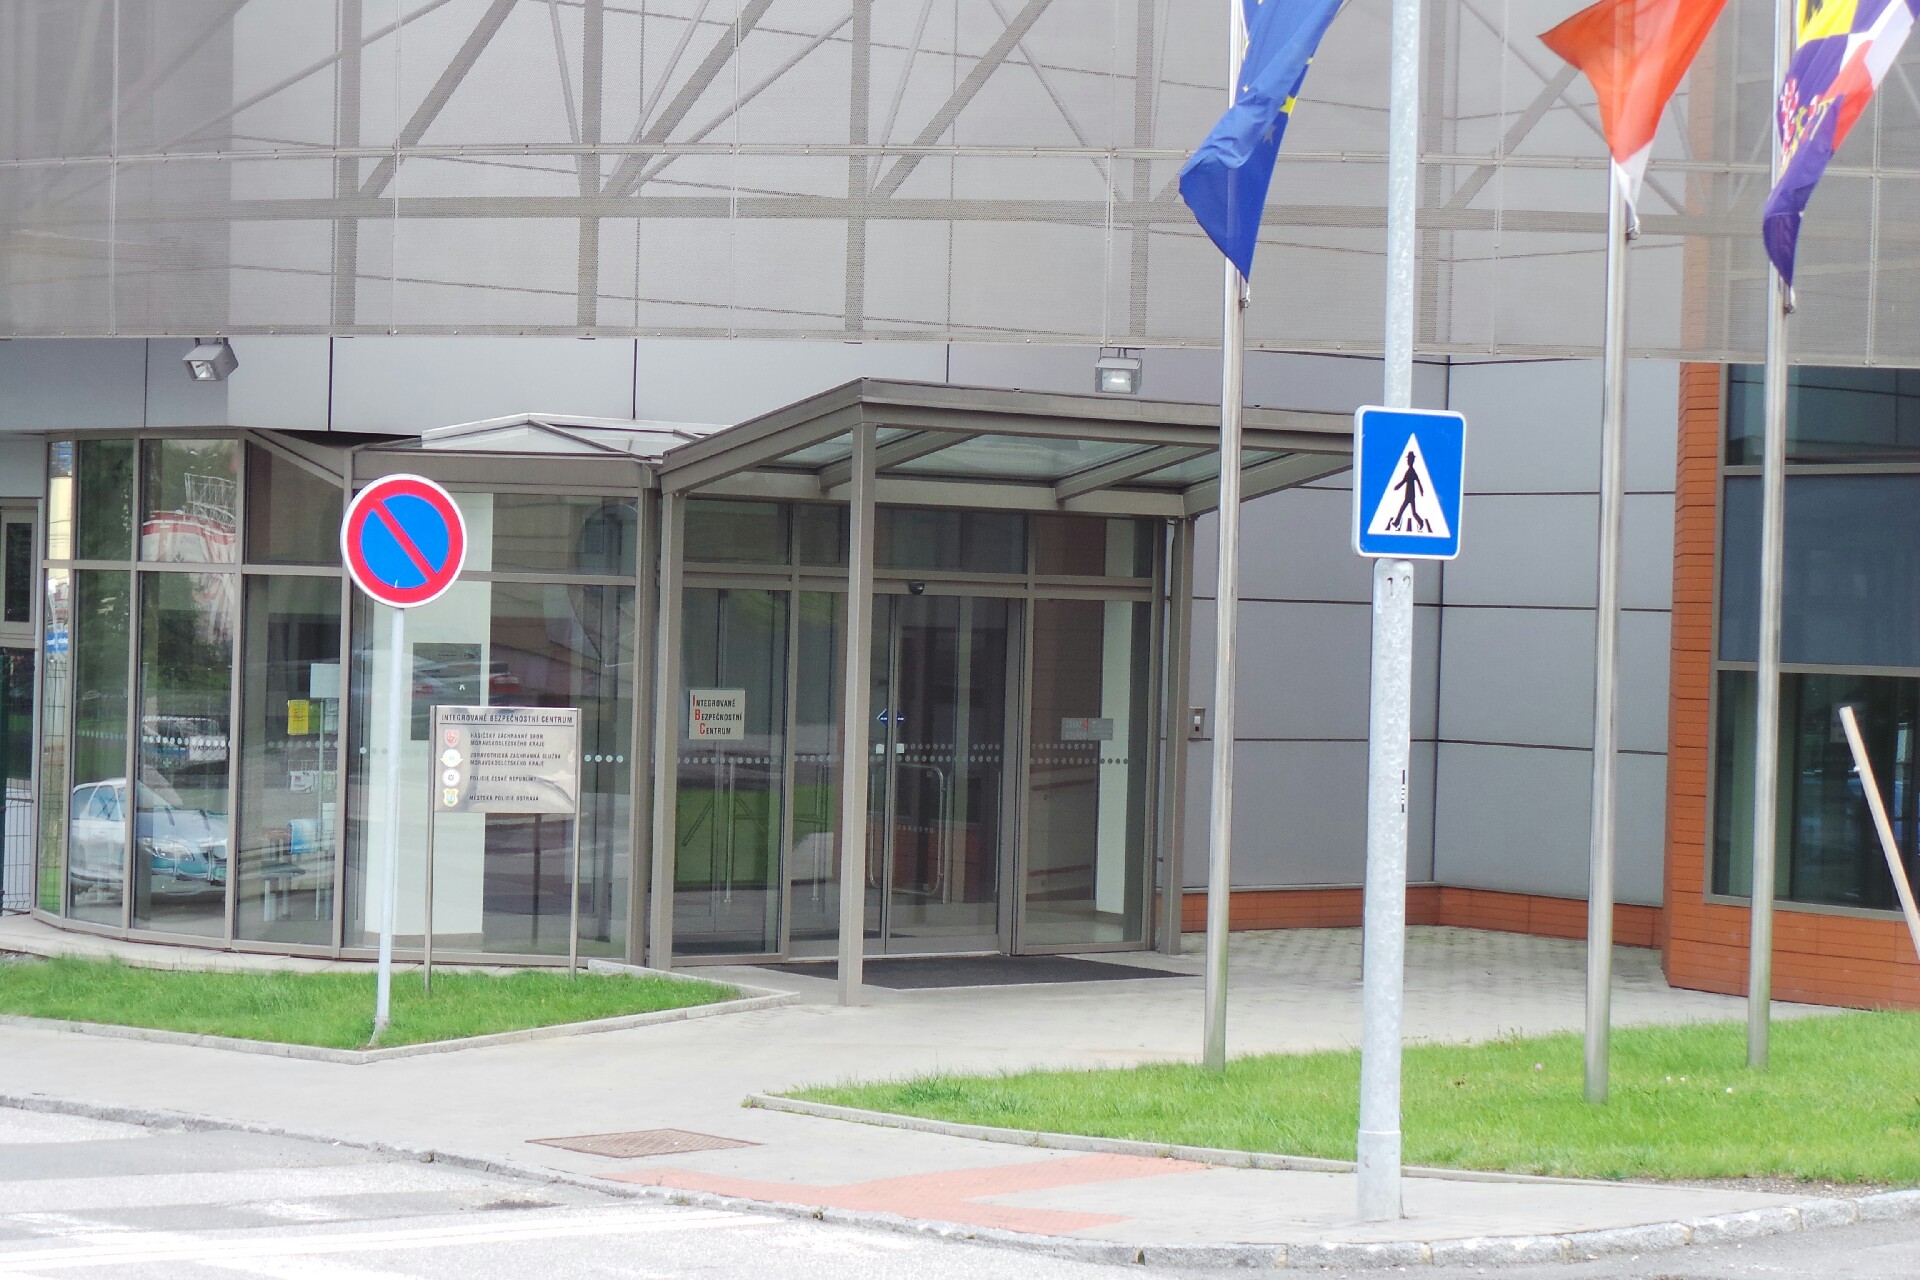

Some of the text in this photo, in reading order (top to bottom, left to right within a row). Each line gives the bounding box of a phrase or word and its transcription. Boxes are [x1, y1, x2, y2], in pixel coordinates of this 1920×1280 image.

[693, 695, 736, 707] INTEGROVANÉ
[442, 714, 486, 722] INTEGROVANÉ
[490, 714, 539, 723] BEZPEČNOSTNÍ
[695, 709, 742, 721] BEZPEČNOSTNÍ
[700, 723, 731, 734] CENTRUM
